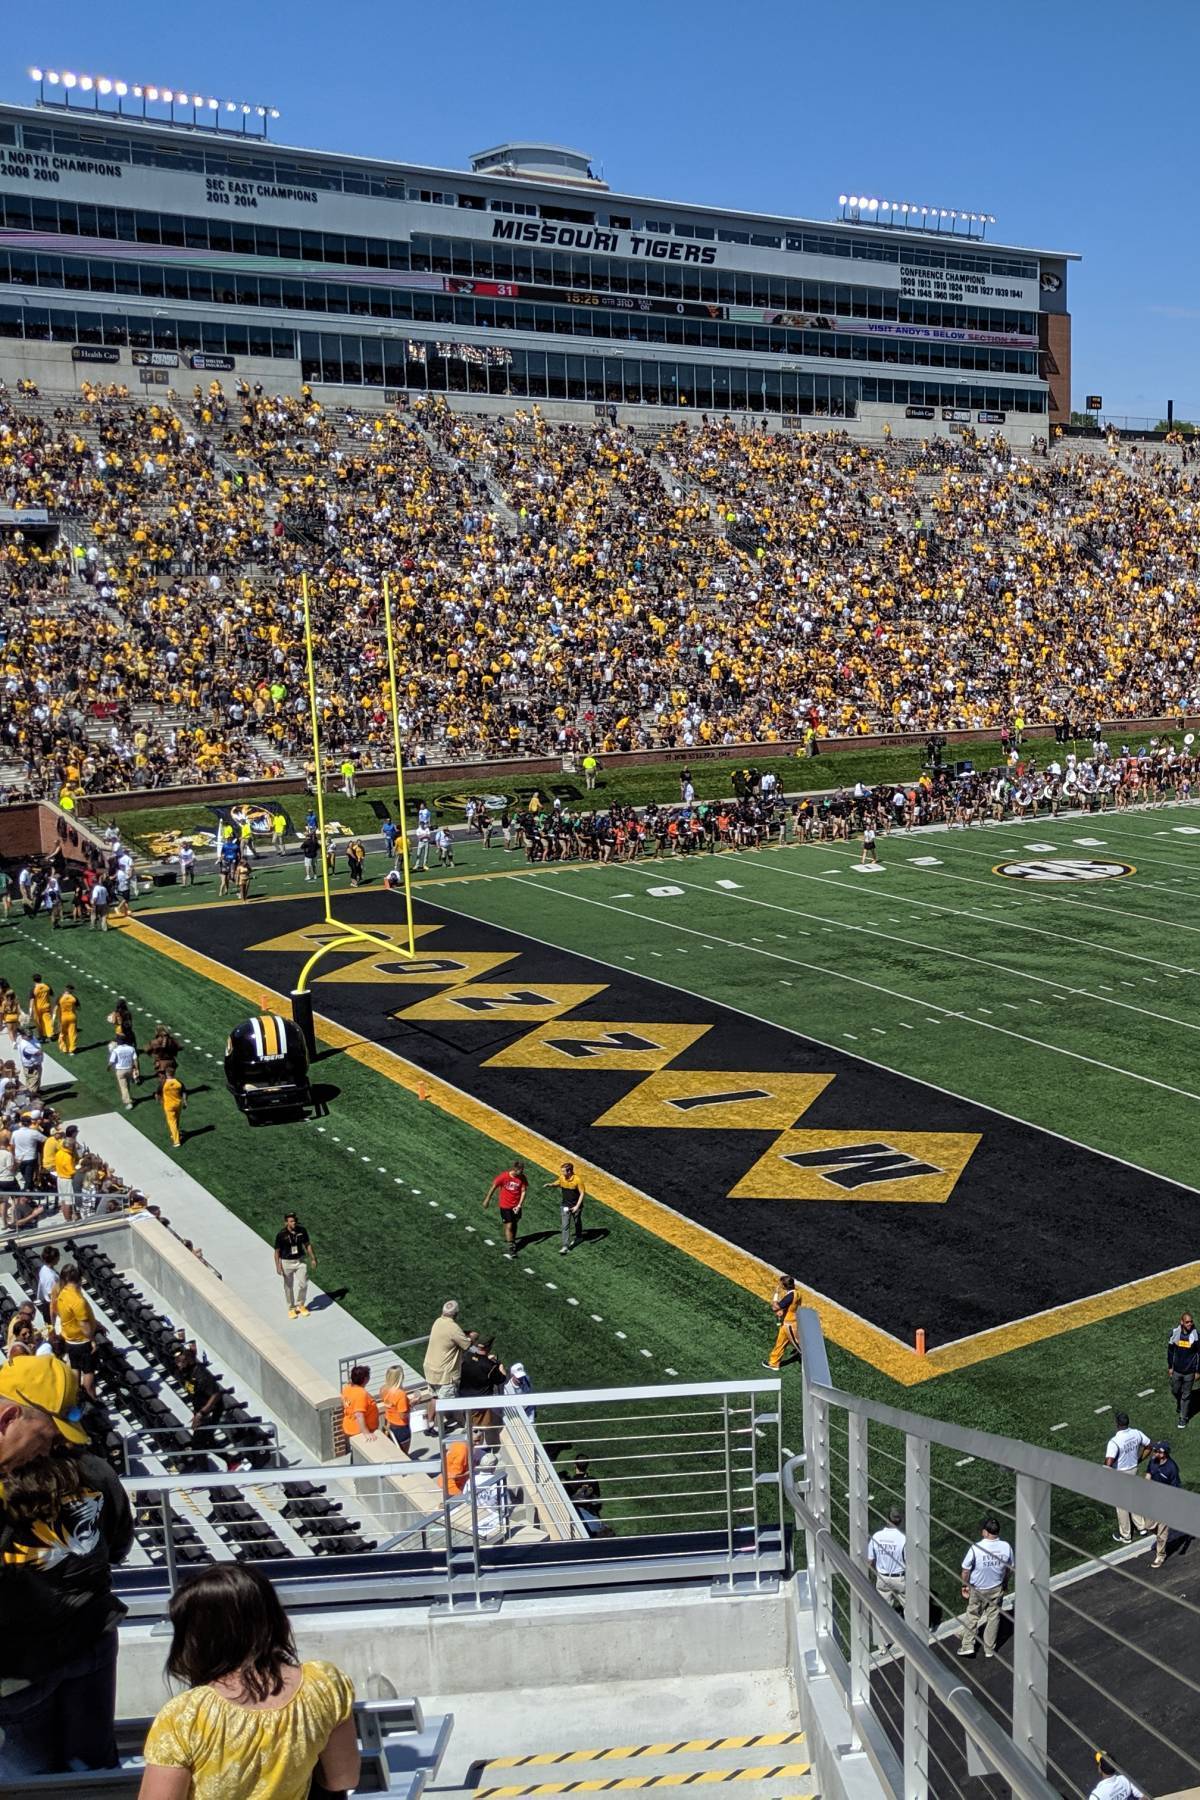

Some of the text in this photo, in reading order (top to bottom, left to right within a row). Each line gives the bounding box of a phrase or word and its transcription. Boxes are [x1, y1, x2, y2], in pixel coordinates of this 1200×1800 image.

[1, 164, 60, 182] 2008 2010
[9, 152, 48, 168] NORTH
[52, 158, 122, 178] CHAMPIONS
[206, 178, 318, 203] SEC EAST CHAMPIONS
[206, 191, 258, 208] 2013 2014
[492, 219, 718, 264] MISSOURI TIGERS
[900, 267, 986, 285] CONFERENCE CHAMPIONS
[496, 285, 513, 296] 31
[616, 298, 634, 308] 3RD
[676, 303, 684, 314] 0
[868, 324, 892, 332] VISIT
[895, 327, 930, 336] ANDY'S
[933, 330, 965, 339] BELOW
[968, 334, 1008, 343] SECTION
[81, 350, 118, 360] Health Care
